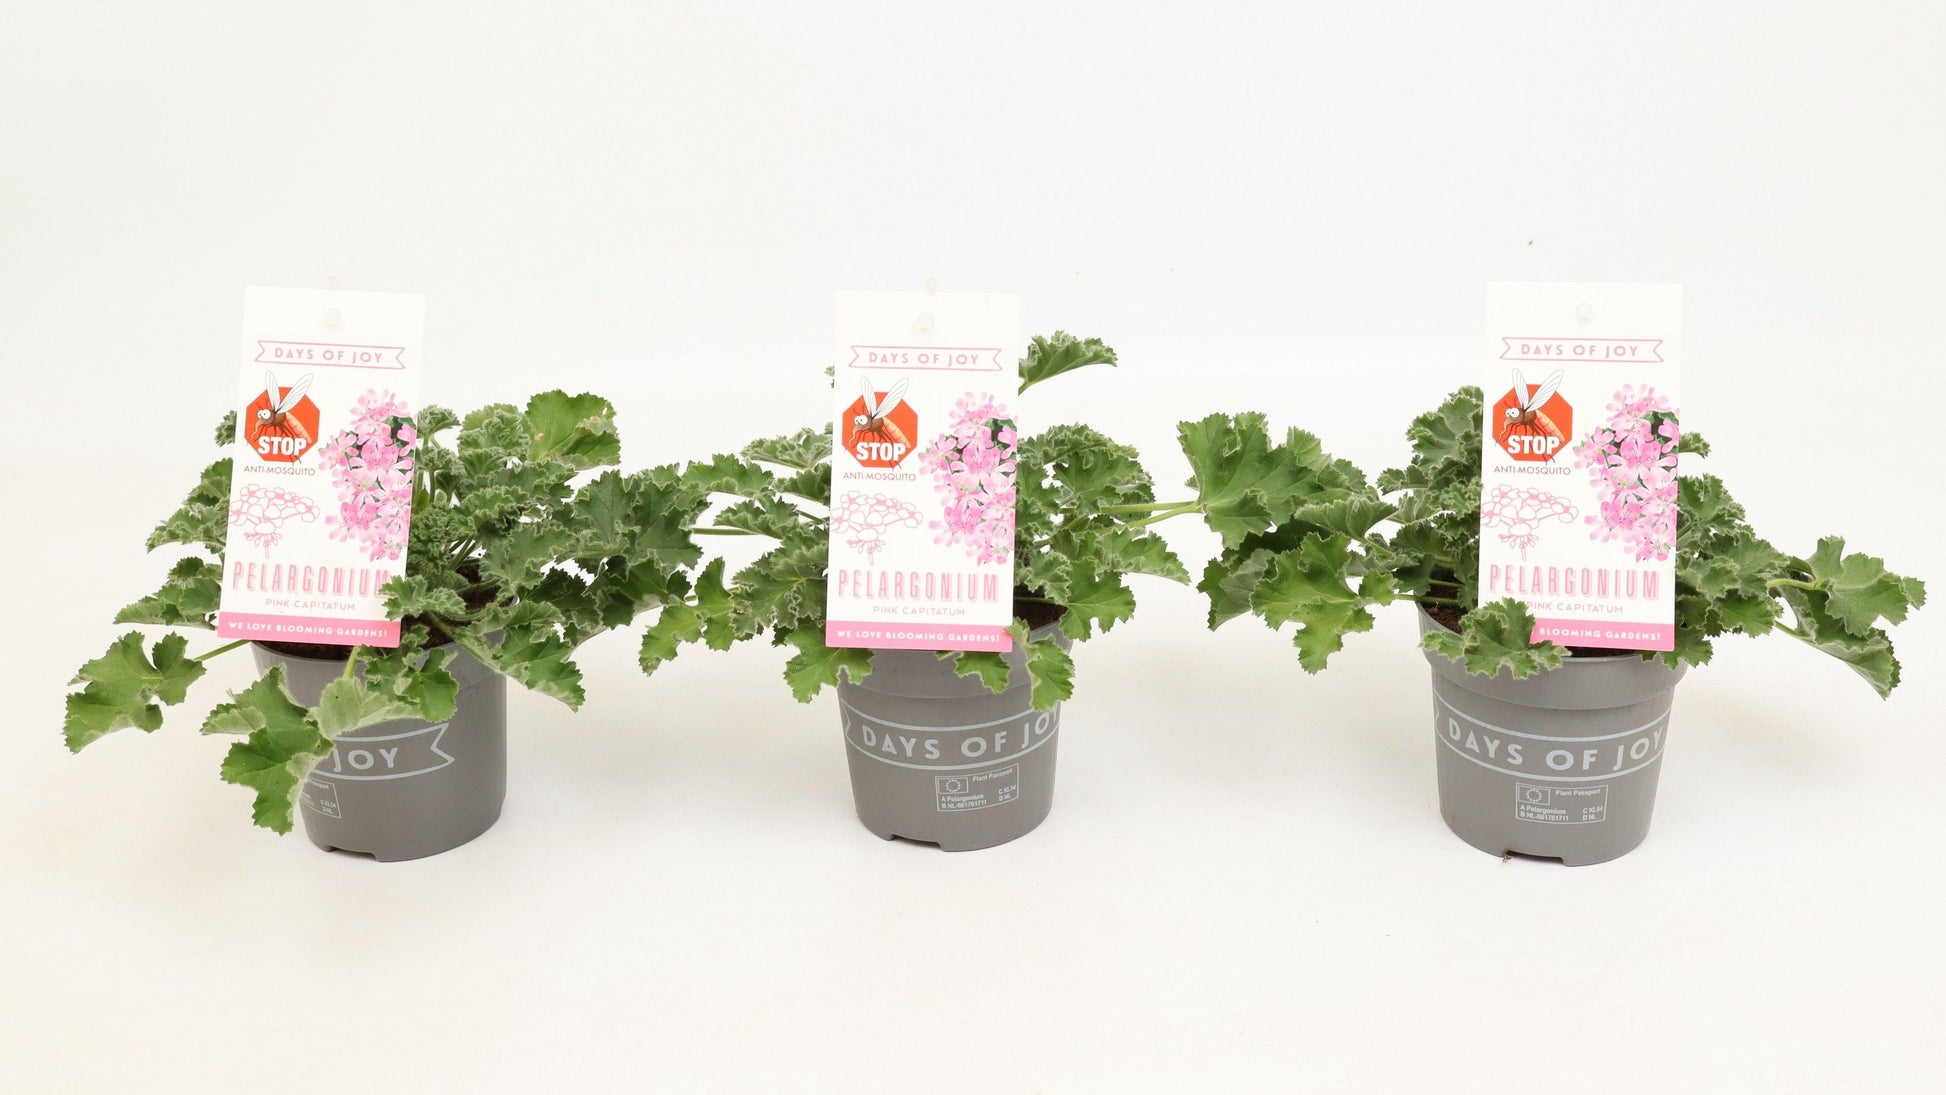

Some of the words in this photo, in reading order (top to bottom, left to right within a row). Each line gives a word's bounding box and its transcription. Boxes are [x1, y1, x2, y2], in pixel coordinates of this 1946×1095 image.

[275, 347, 314, 360] DAYS
[322, 350, 344, 361] OF
[352, 351, 383, 364] JOY
[1521, 344, 1563, 355] DAYS
[1573, 345, 1596, 356] OF
[1605, 345, 1639, 358] JOY
[869, 352, 909, 364] DAYS
[918, 353, 939, 364] OF
[948, 354, 979, 367] JOY
[258, 436, 307, 456] STOP
[1507, 435, 1560, 455] STOP
[855, 442, 906, 462] STOP
[244, 465, 315, 476] ANTI-MOSQUITO
[1493, 465, 1571, 475] ANTI-MOSQUITO
[842, 472, 916, 482] ANTI-MOSQUITO
[838, 569, 999, 603] PELARGONIUM
[1489, 564, 1659, 601] PELARGONIUM
[265, 598, 289, 608] PINK
[294, 600, 356, 611] CAPITATUM
[1527, 601, 1552, 610] PINK
[1557, 602, 1624, 614] CAPITATUM
[873, 606, 898, 615] PINK
[902, 606, 965, 617] CAPITATUM
[247, 623, 272, 631] LOVE
[276, 624, 332, 635] BLOOMING
[337, 627, 387, 638] GARDENS!
[856, 631, 881, 639] LOVE
[886, 631, 944, 641] BLOOMING
[948, 633, 1000, 643] GARDENS!
[1540, 628, 1601, 638] BLOOMING
[1605, 630, 1661, 641] GARDENS!
[862, 724, 940, 760] DAYS
[960, 731, 1007, 758] OF
[1448, 716, 1524, 765] DAYS
[1546, 749, 1598, 770] OF
[1613, 726, 1664, 771] JOY
[333, 747, 398, 772] JOY
[988, 768, 1013, 779] Passport
[947, 794, 984, 803] Pelargonium
[1573, 788, 1600, 796] Passport
[1527, 805, 1566, 814] Pelargonium
